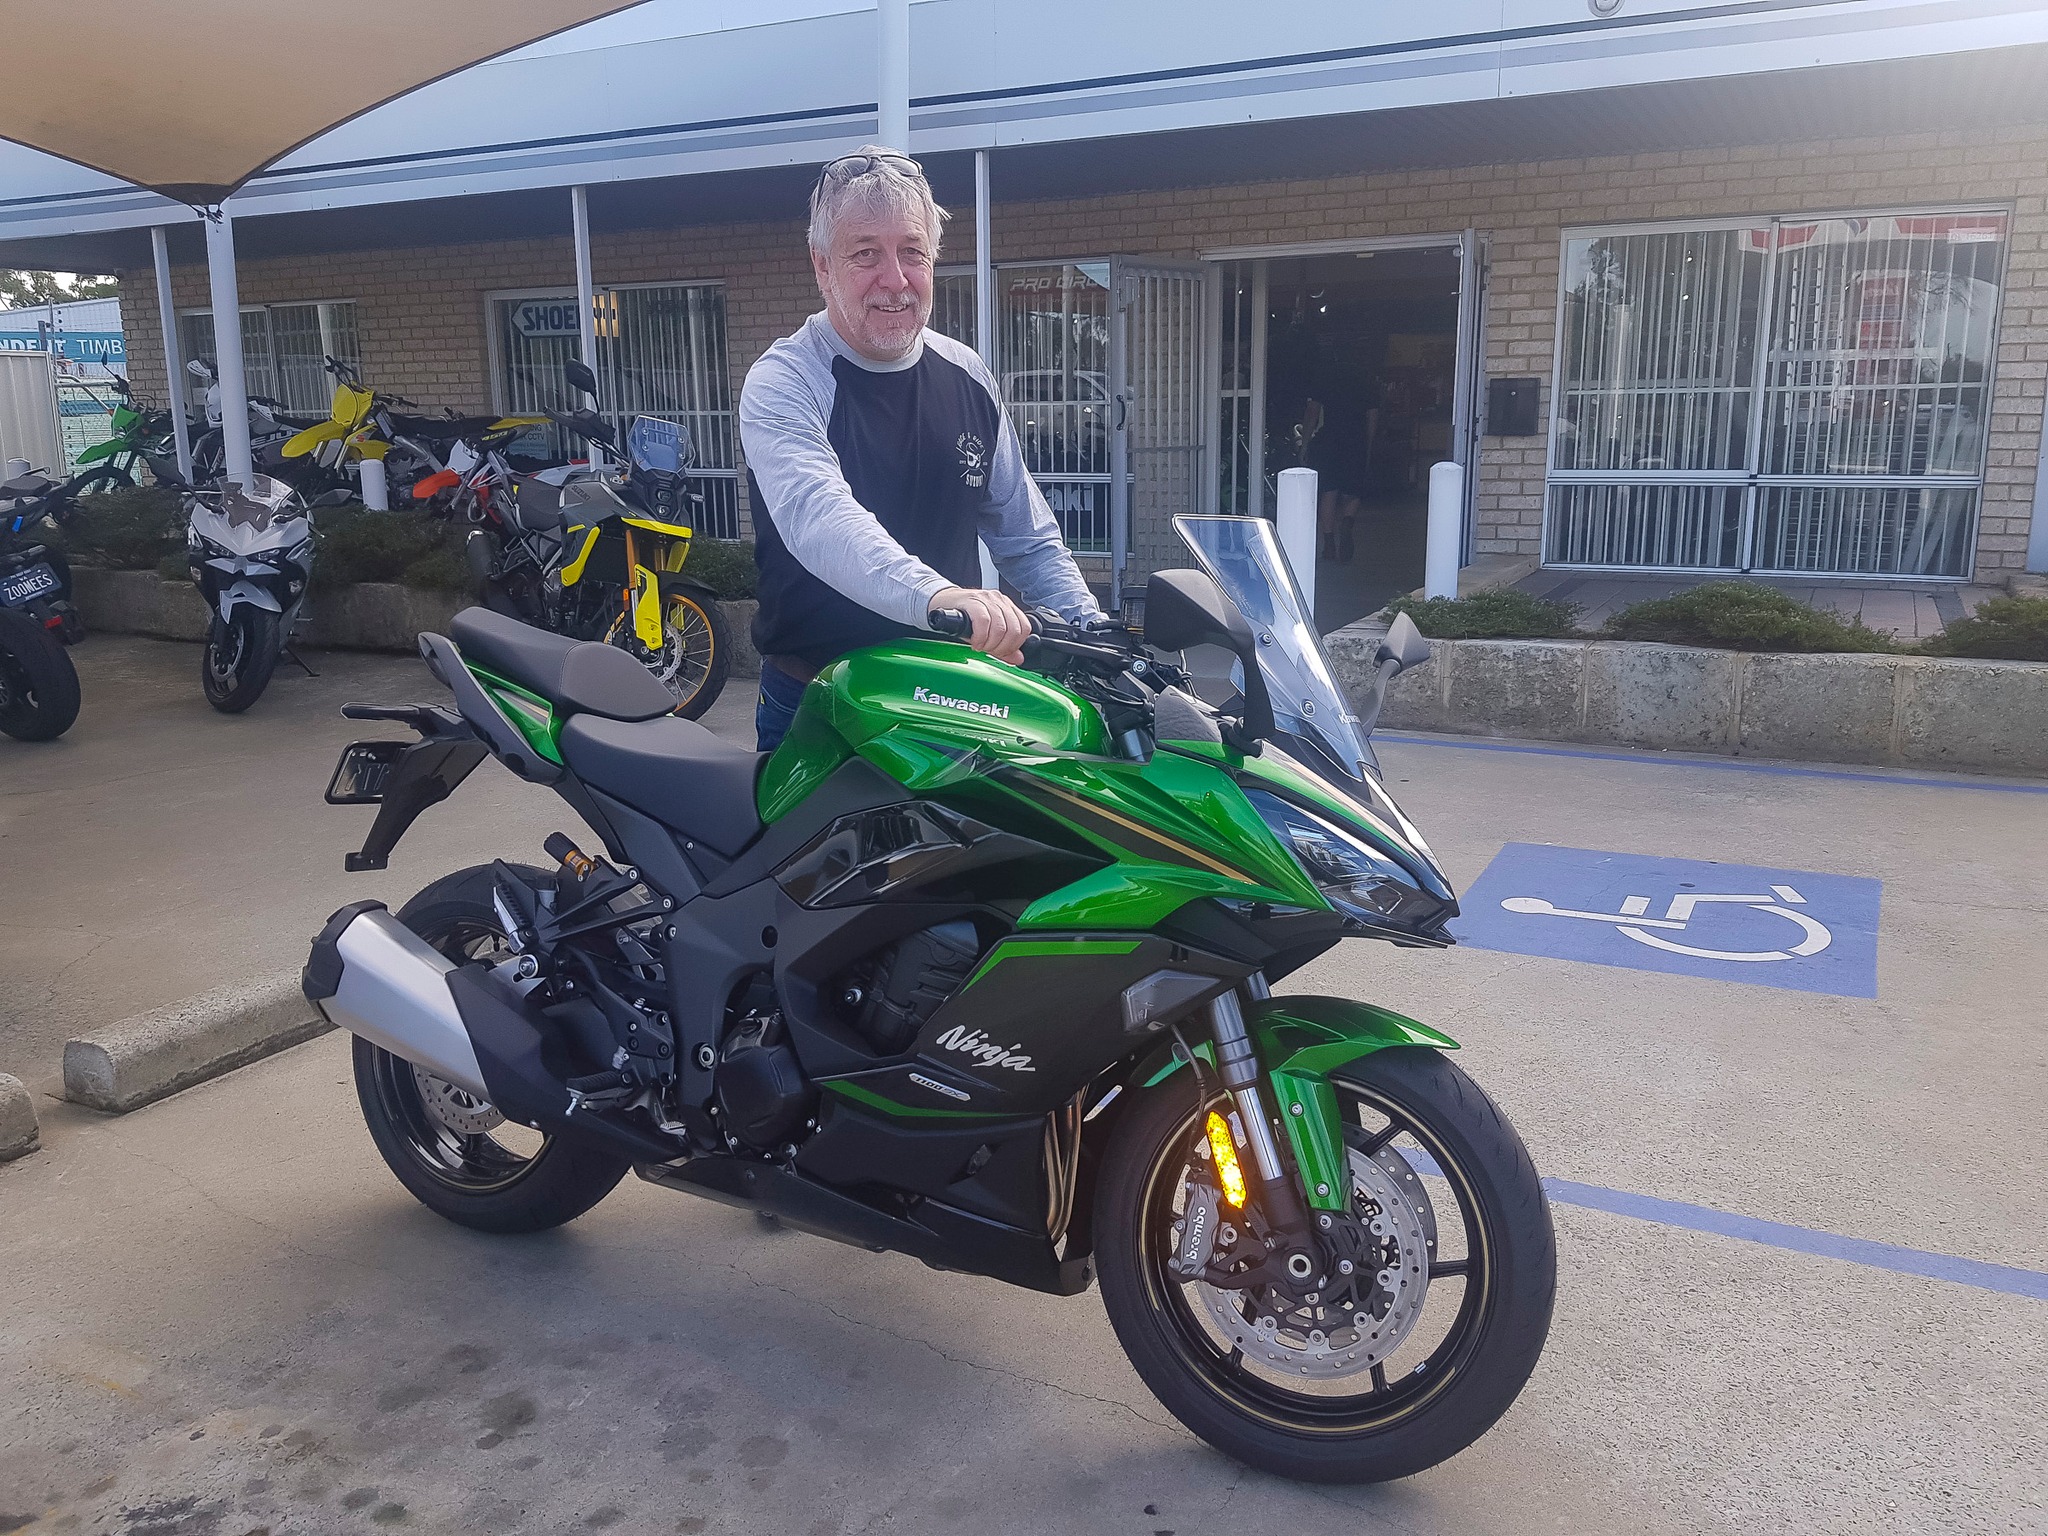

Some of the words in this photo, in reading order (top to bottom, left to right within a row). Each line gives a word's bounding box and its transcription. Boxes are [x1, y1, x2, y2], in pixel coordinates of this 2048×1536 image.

[1010, 277, 1051, 293] PRO
[76, 339, 123, 354] TIMB
[913, 686, 1010, 719] Kawasaki
[936, 1025, 1036, 1072] Ninja
[1186, 1206, 1207, 1260] brembo
